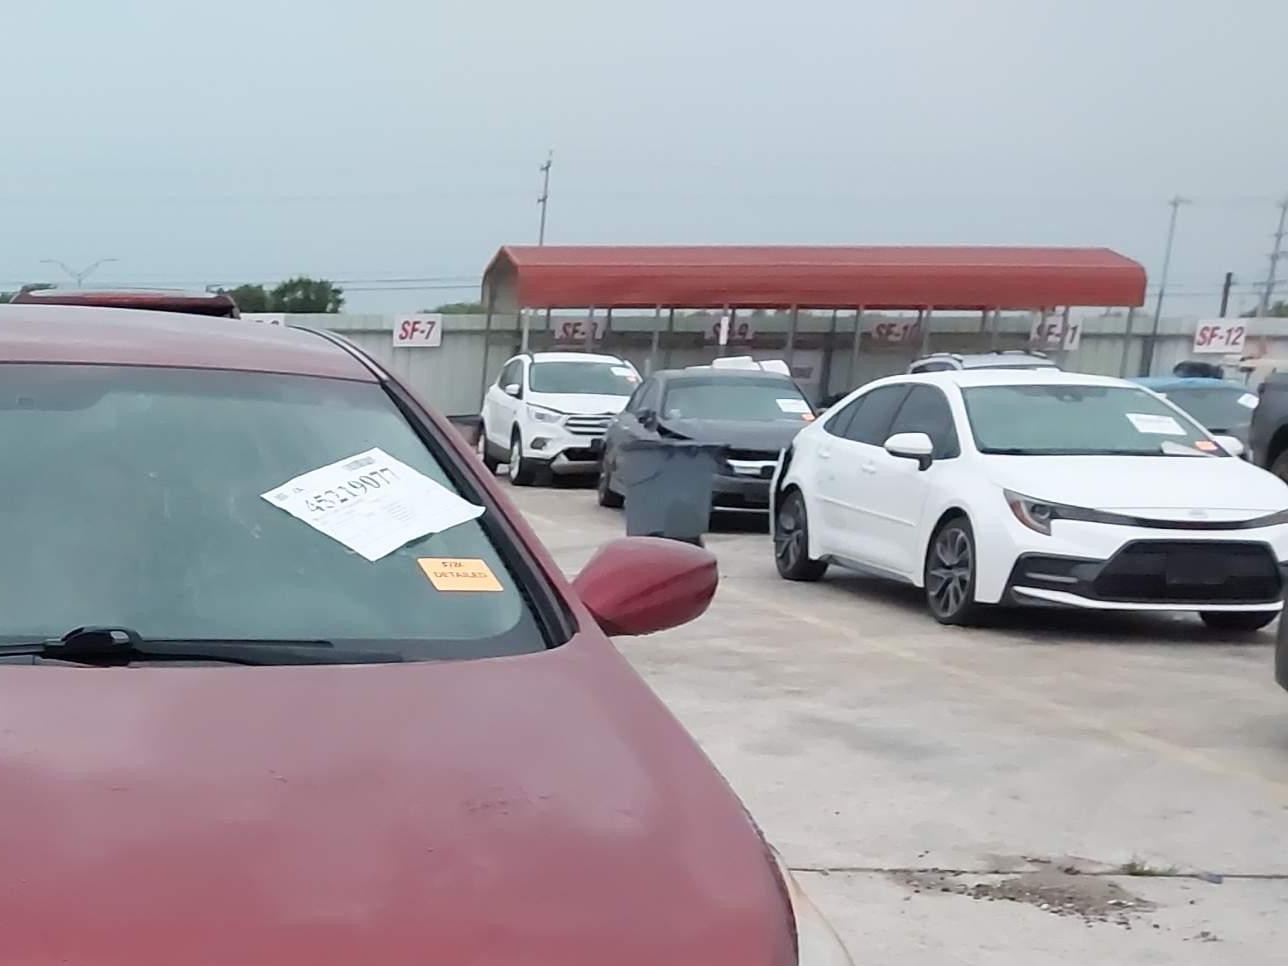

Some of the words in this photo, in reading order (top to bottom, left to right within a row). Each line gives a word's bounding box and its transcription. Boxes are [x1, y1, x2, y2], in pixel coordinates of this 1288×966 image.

[398, 320, 437, 340] SF-7
[1196, 326, 1244, 346] SF-12
[304, 466, 401, 512] 45219077
